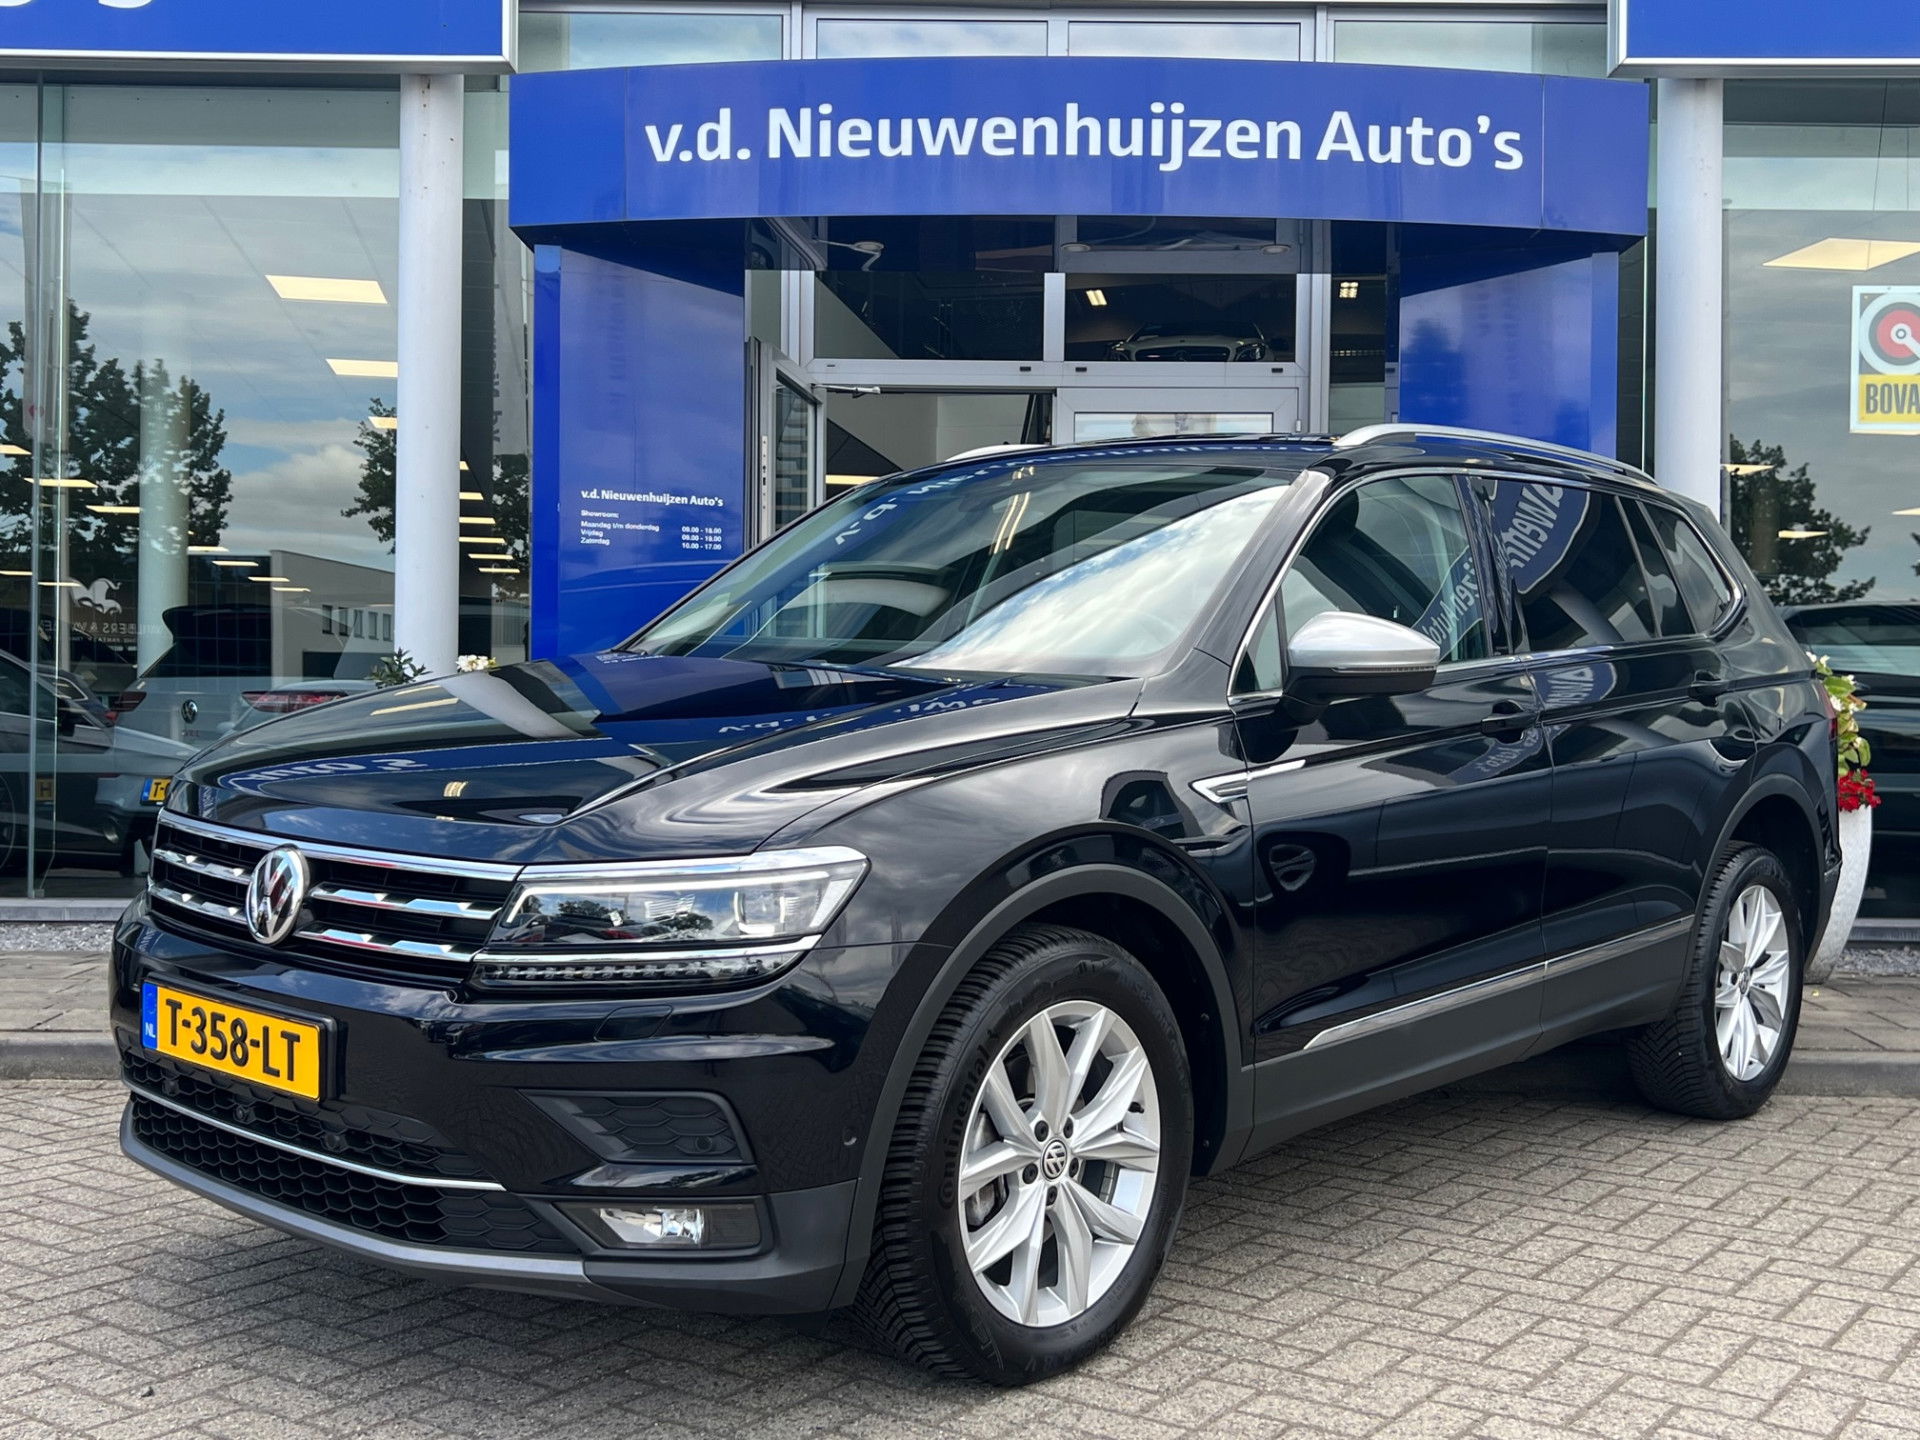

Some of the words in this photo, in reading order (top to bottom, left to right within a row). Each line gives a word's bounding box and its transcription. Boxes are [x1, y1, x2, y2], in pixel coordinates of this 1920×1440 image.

[644, 107, 751, 162] v.d.
[768, 101, 1300, 172] Nieuwenhuijzen
[1316, 110, 1524, 170] Auto's
[581, 488, 600, 499] v.d.
[601, 490, 688, 505] Nieuwenhuijzen
[689, 495, 724, 507] Auto's
[144, 1022, 156, 1039] NL
[166, 998, 301, 1081] T-358-LT
